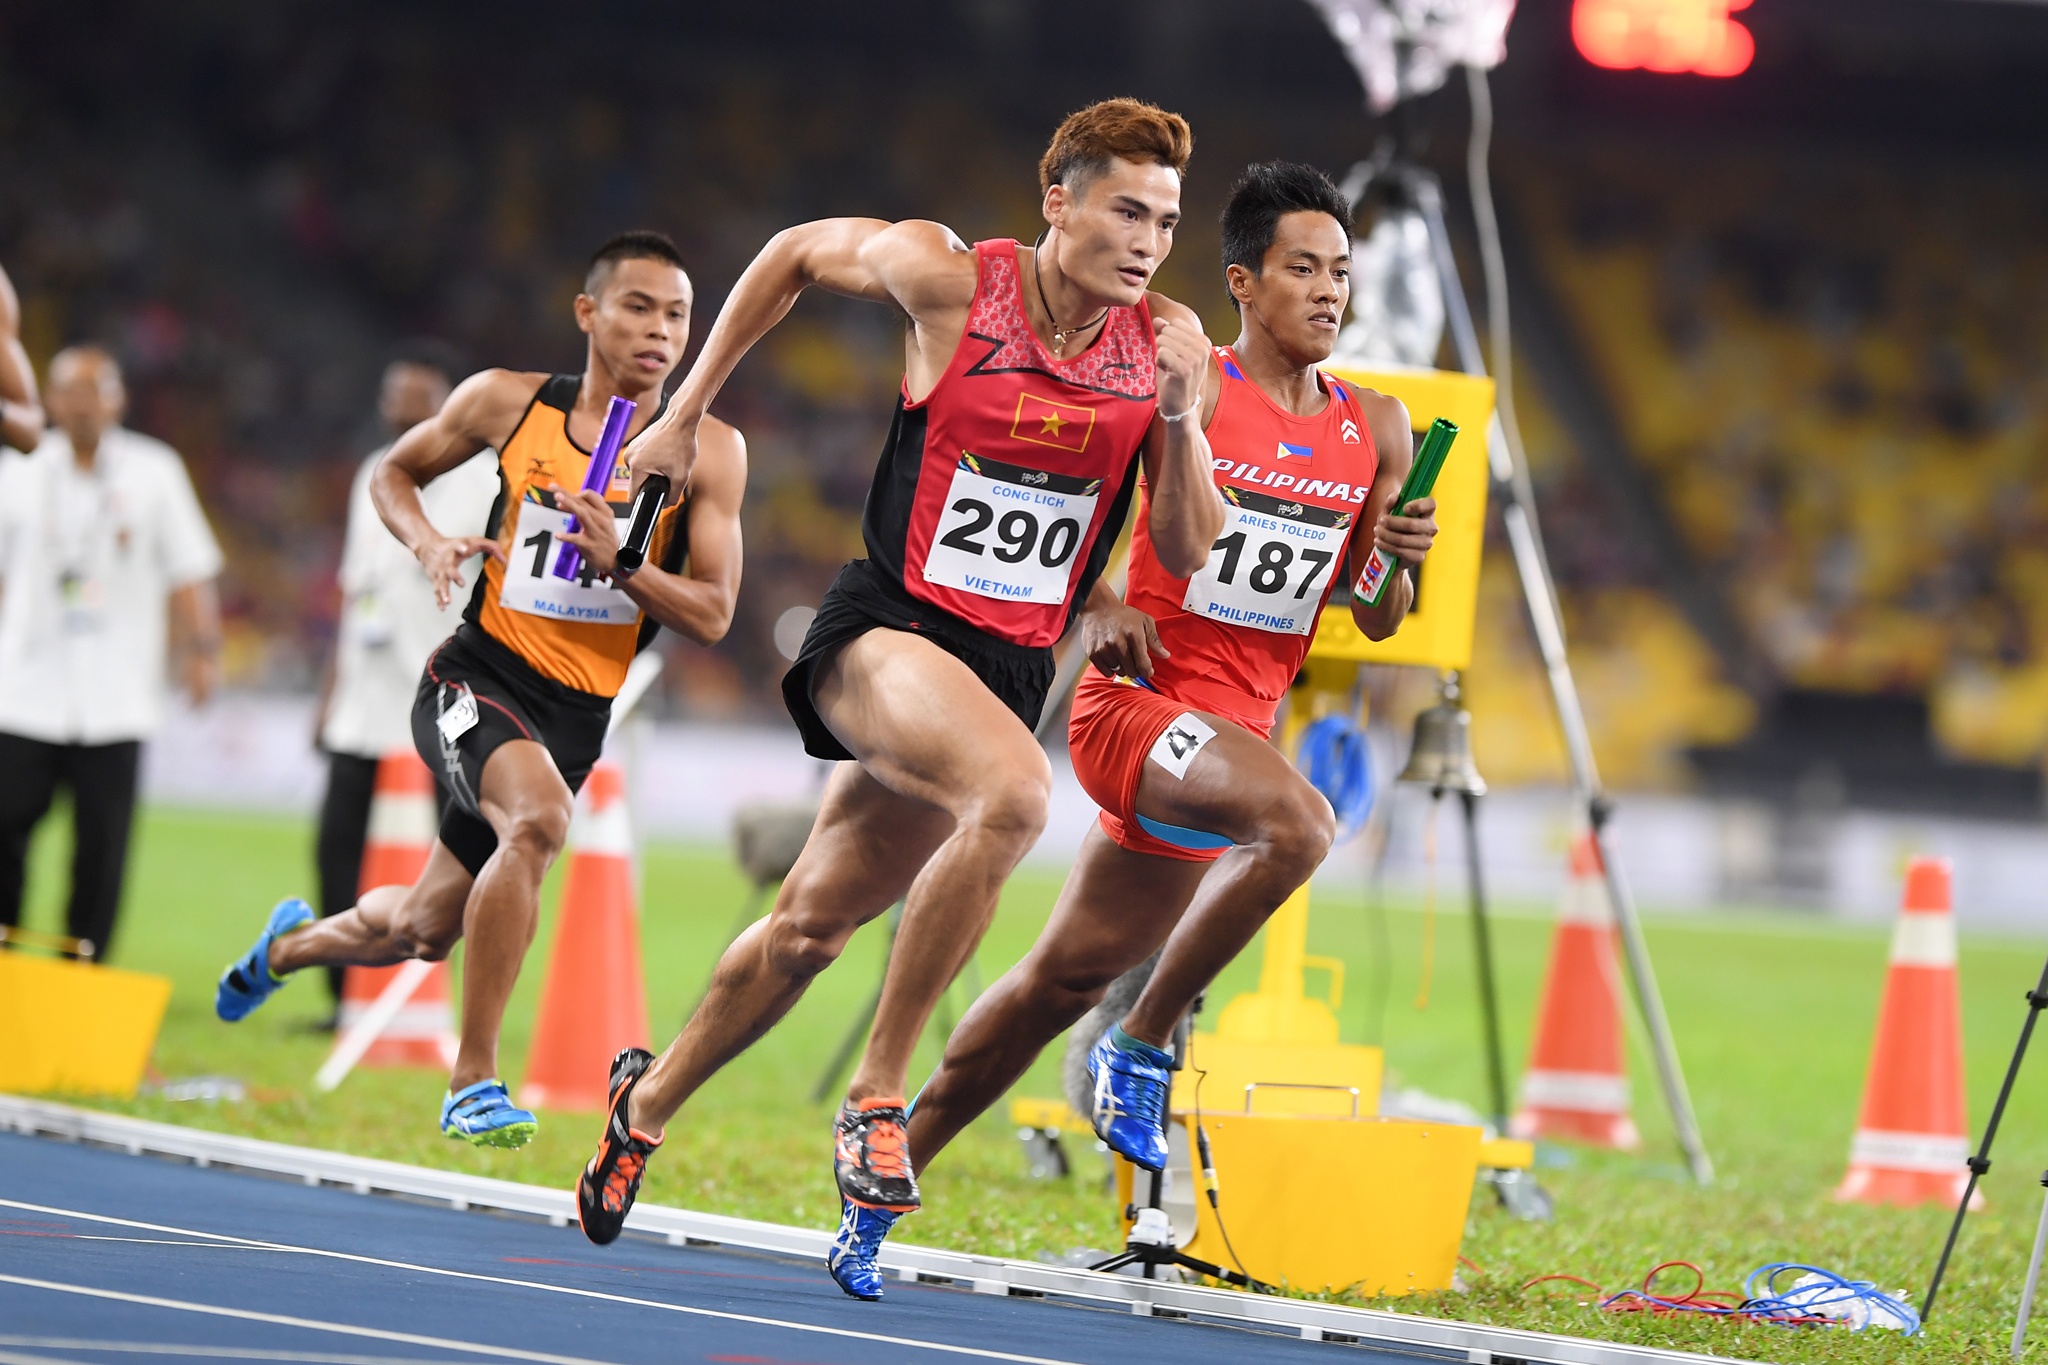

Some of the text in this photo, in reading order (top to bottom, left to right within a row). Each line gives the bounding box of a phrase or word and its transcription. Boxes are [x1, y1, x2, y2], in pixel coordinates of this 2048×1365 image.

[1212, 457, 1369, 504] PILIPINAS
[992, 485, 1065, 508] CONG LICH
[939, 498, 1080, 568] 290
[1238, 513, 1326, 541] ARIES TOLEDO
[1211, 530, 1333, 600] 187
[965, 574, 1033, 597] VIETNAM
[534, 599, 609, 619] MALAYSIA
[1207, 602, 1295, 630] PHILIPPINES
[1166, 725, 1199, 760] 4
